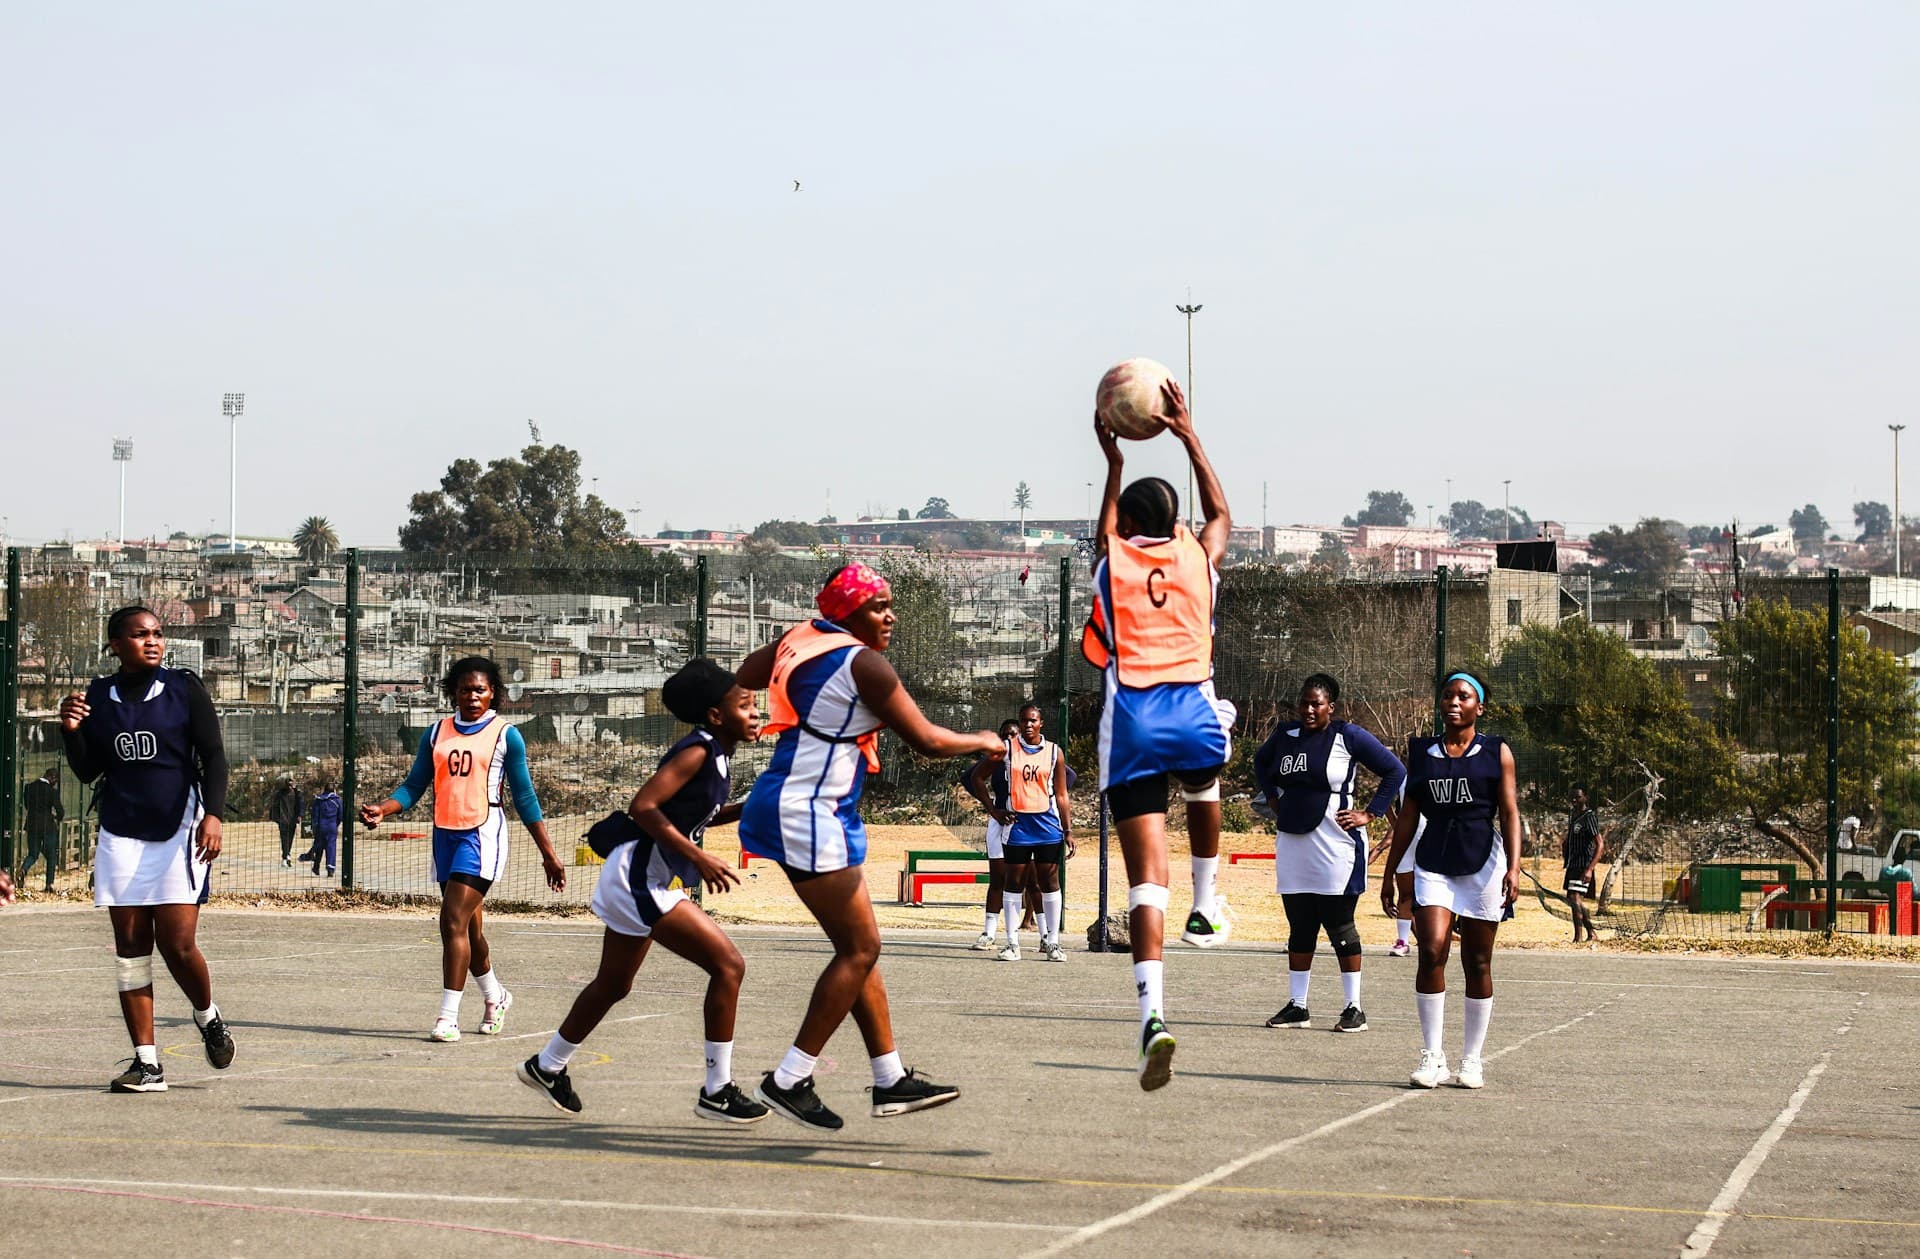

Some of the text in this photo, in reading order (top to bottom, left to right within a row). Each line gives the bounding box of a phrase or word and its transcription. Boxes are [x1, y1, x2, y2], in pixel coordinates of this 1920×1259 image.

[1147, 567, 1167, 608] C
[114, 731, 157, 761] GD
[448, 749, 472, 777] GD
[1022, 764, 1040, 782] GK
[1280, 753, 1307, 775] GA
[1429, 778, 1473, 803] WA
